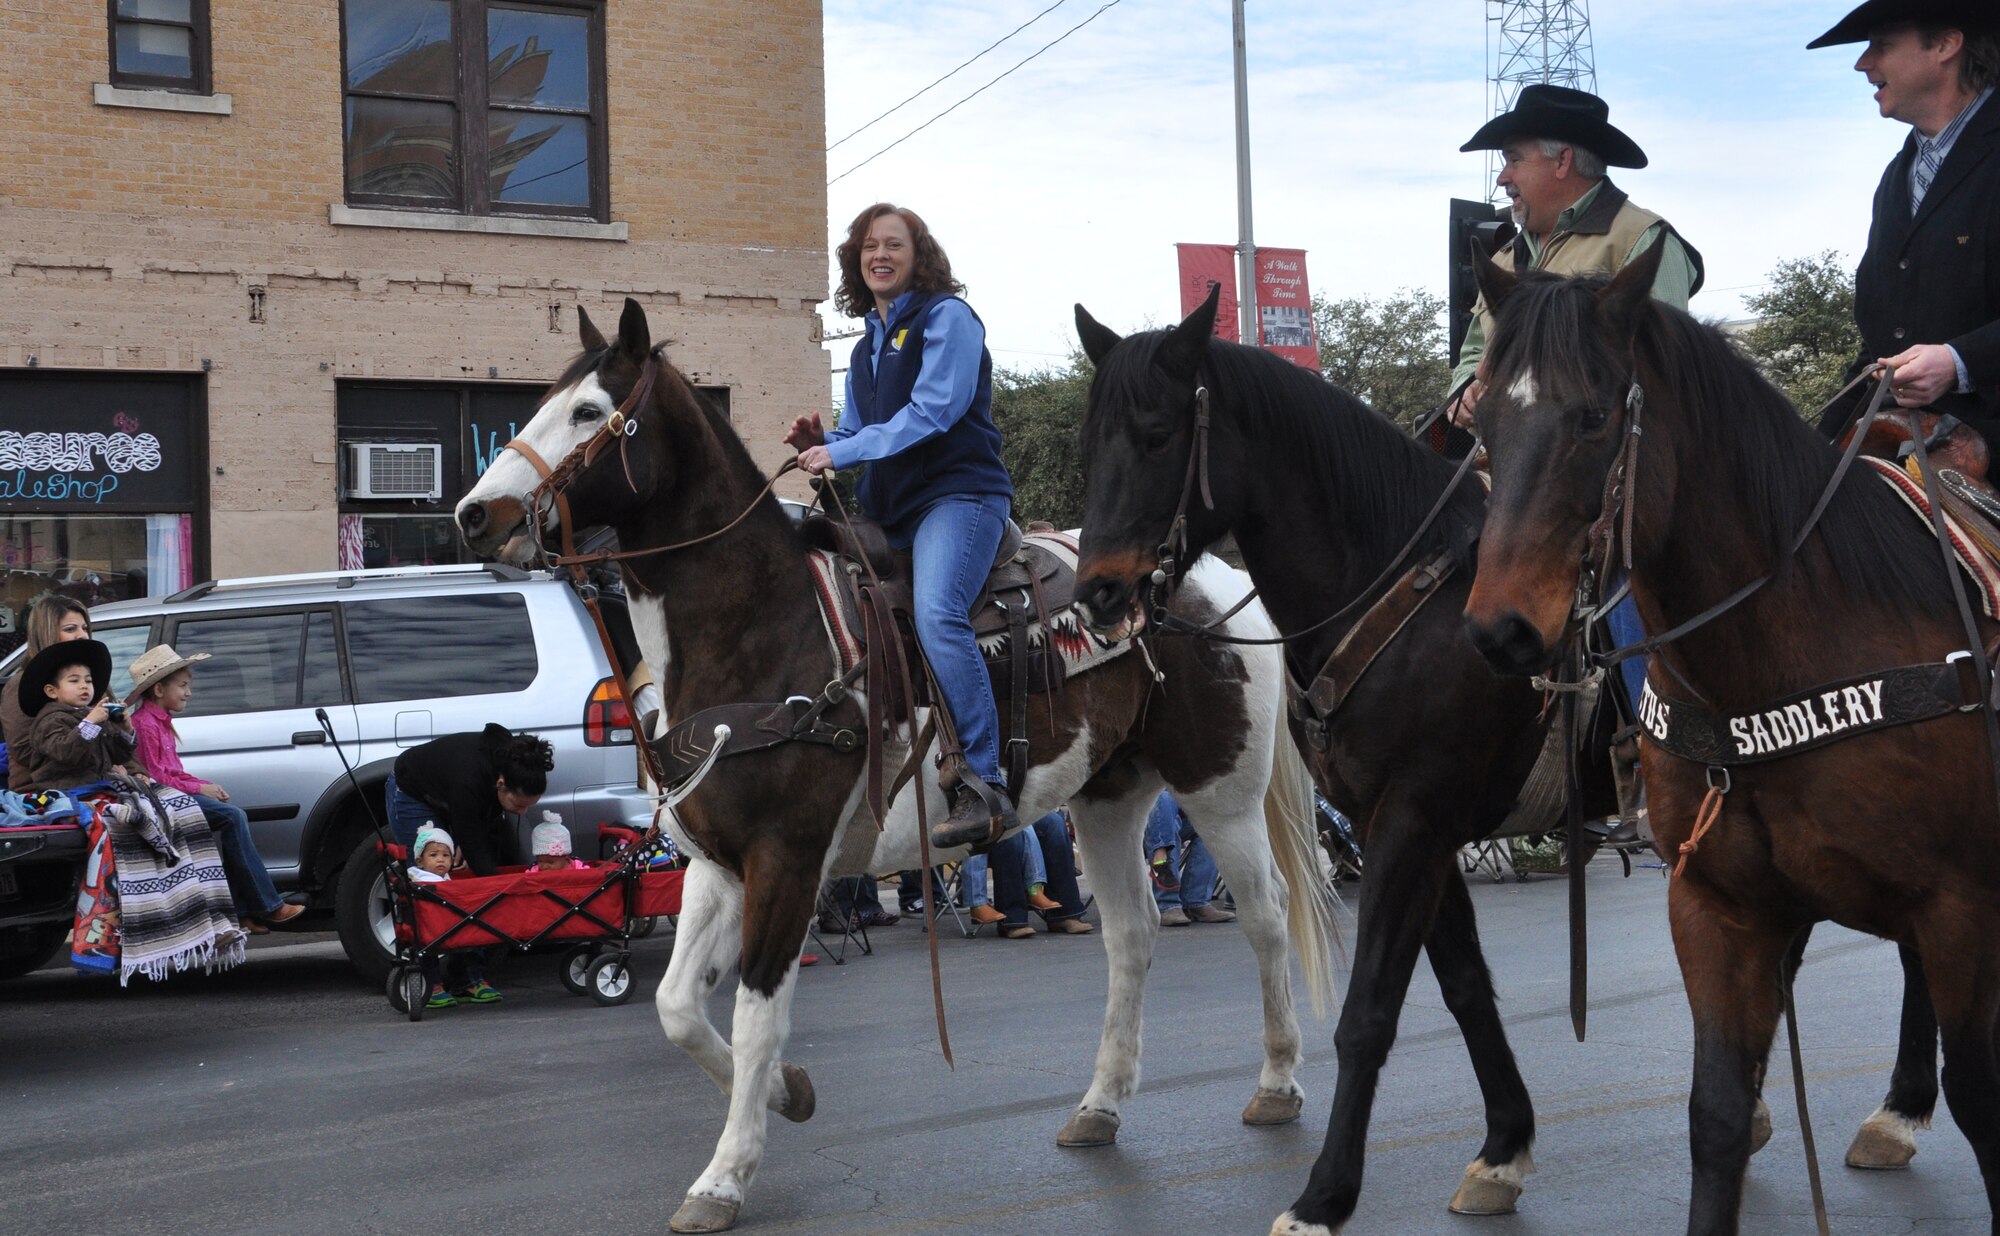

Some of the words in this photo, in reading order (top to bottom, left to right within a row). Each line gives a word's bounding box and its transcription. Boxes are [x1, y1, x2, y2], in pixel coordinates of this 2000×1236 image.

[1263, 259, 1275, 270] A
[1275, 259, 1298, 271] Walk
[1262, 273, 1302, 288] Through
[1272, 287, 1297, 299] Time
[1729, 679, 1884, 756] SADDLERY
